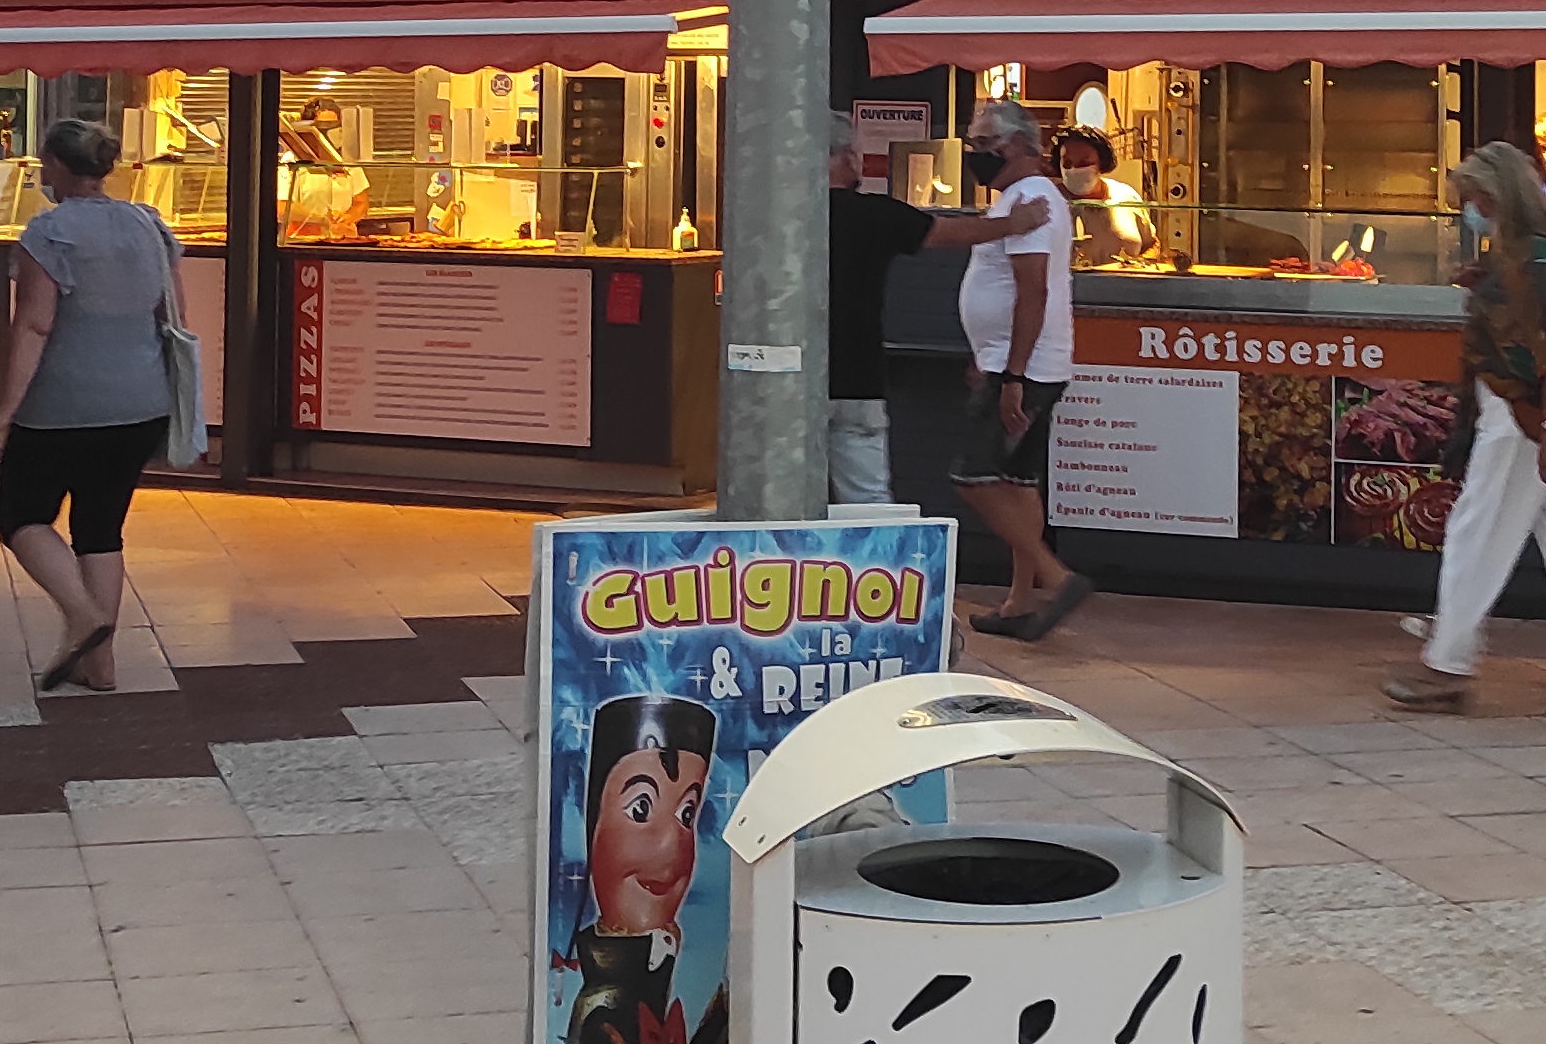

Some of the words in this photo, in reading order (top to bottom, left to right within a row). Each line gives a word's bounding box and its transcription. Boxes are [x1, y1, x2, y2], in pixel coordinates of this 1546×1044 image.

[860, 109, 924, 121] OUVERTURE
[299, 266, 319, 424] PIZZAS
[1138, 326, 1385, 369] Rôtisserie
[581, 545, 925, 637] Guignol
[709, 646, 743, 699] &
[821, 628, 852, 656] la
